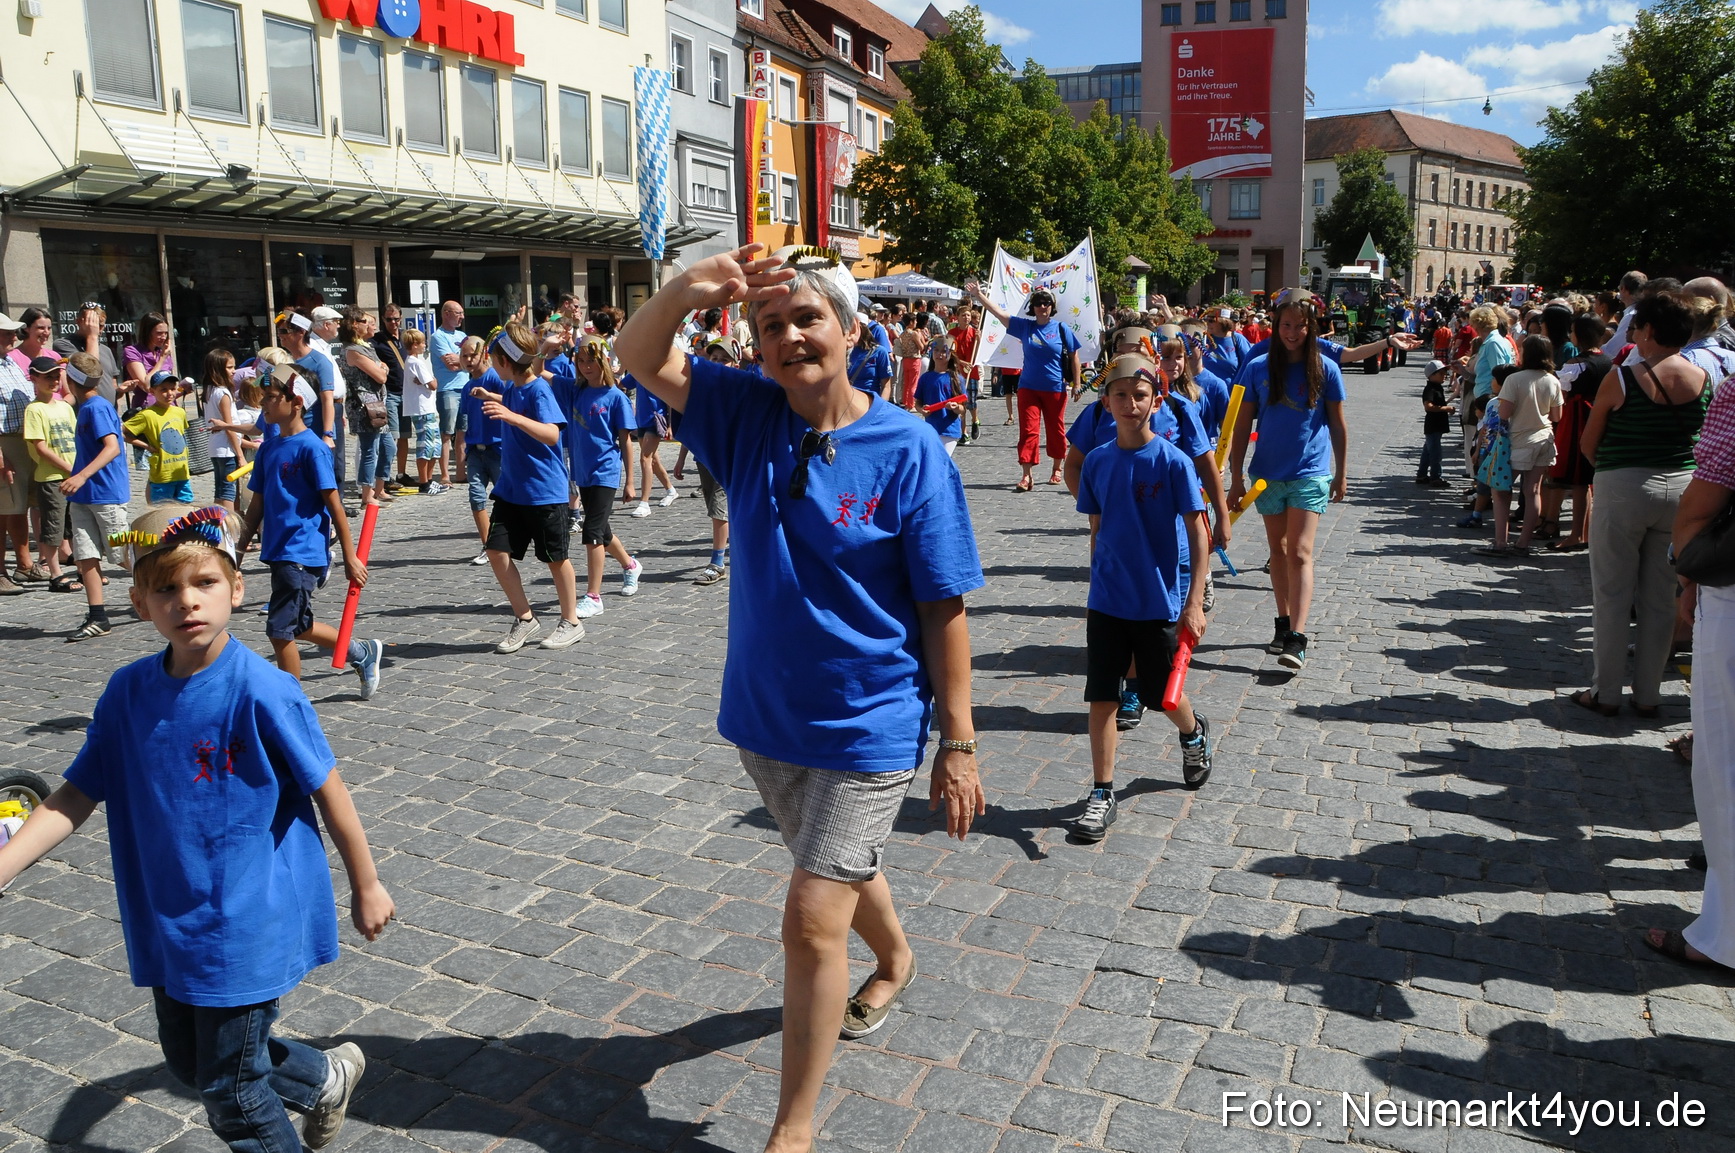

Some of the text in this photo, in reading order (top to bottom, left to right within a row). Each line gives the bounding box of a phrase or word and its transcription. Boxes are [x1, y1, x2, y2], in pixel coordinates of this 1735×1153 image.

[1178, 66, 1215, 78] Danke
[1177, 83, 1188, 91] für
[1201, 82, 1238, 90] Vertrauen
[1177, 93, 1192, 101] und
[1207, 117, 1241, 133] 175
[1207, 132, 1241, 142] JAHRE
[758, 194, 770, 205] afé
[469, 296, 494, 307] Aktion
